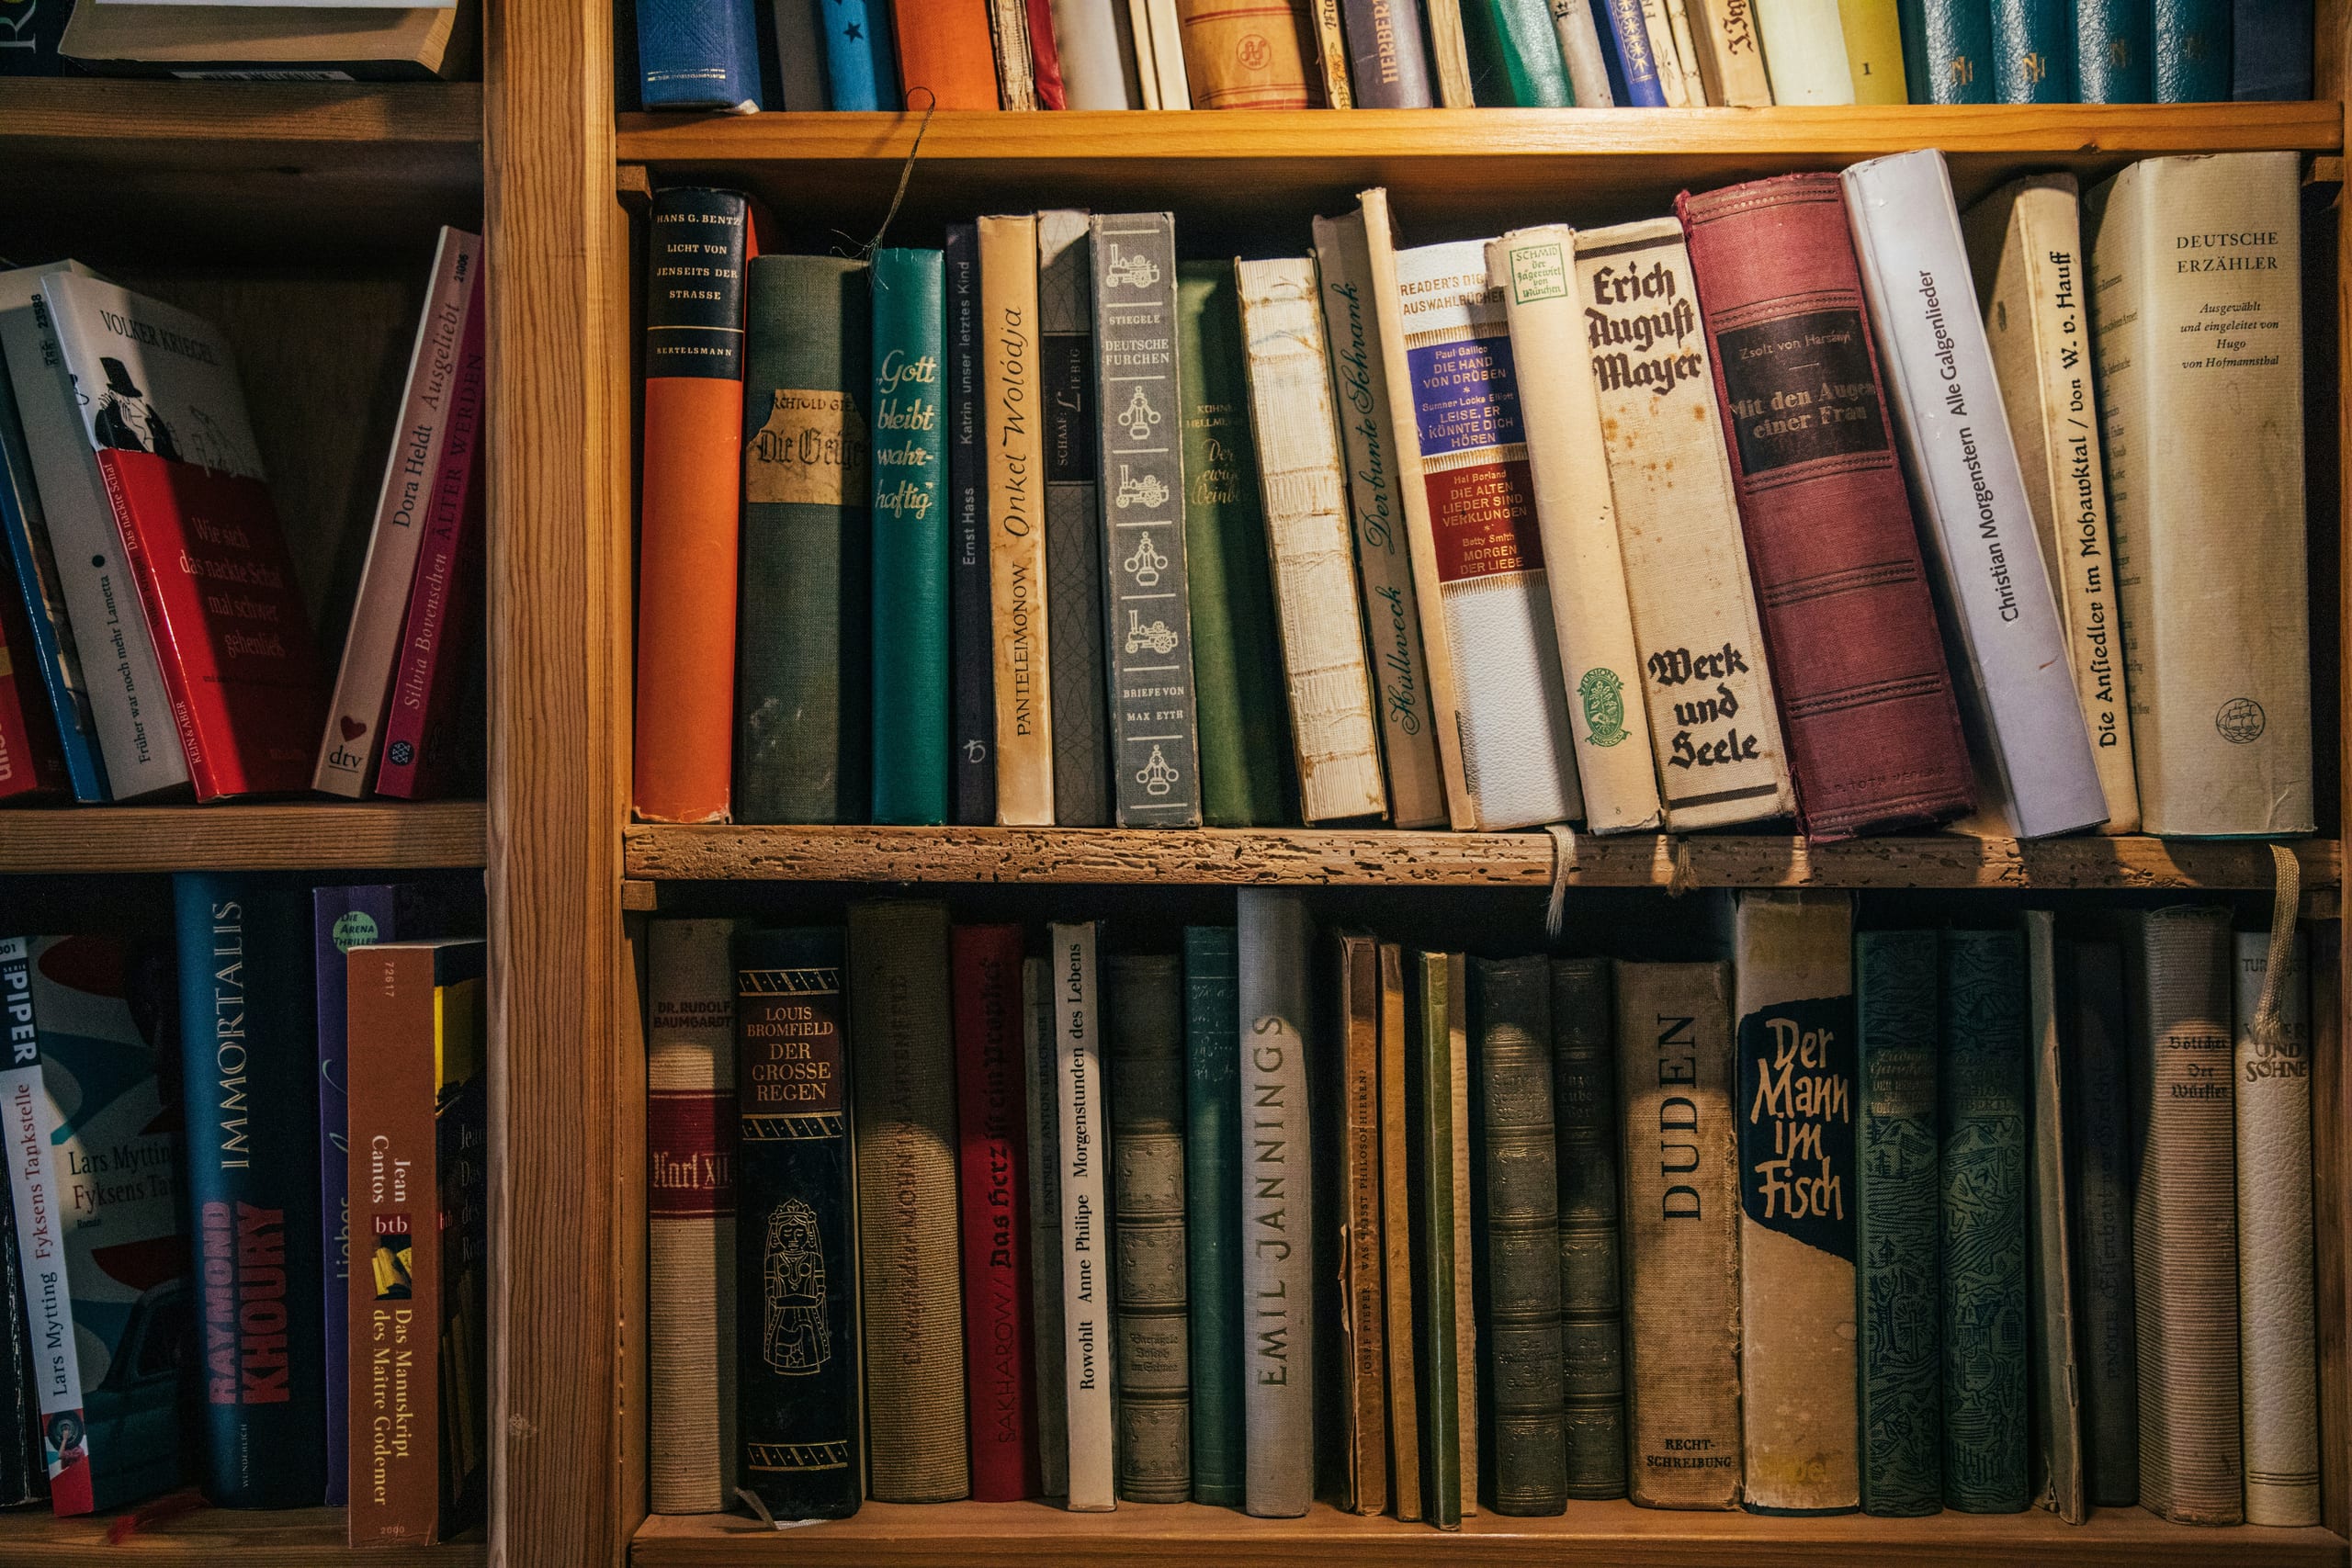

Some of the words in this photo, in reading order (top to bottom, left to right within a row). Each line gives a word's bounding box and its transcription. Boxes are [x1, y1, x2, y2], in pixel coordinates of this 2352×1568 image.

[1379, 0, 1401, 84] HERBER
[656, 213, 685, 225] HANS
[687, 213, 699, 224] G.
[701, 214, 742, 227] BENTZ
[667, 243, 700, 254] LICHT
[704, 244, 728, 255] VON
[1515, 246, 1559, 262] SCHMID
[2176, 231, 2278, 250] DEUTSCHE
[656, 266, 710, 278] JENSEITS
[714, 267, 739, 279] DER
[957, 262, 970, 296] Kind
[2177, 254, 2278, 274] ERZÄHLER
[669, 289, 722, 301] STRASSE
[1521, 283, 1562, 299] München
[1592, 261, 1677, 306] Erich
[30, 293, 49, 329] 23588
[958, 299, 972, 351] letztes
[1108, 314, 1161, 325] STIEGELE
[1584, 298, 1695, 353] August
[1918, 270, 1957, 381] Galgenlieder
[2199, 301, 2261, 316] Ausgewählt
[99, 309, 160, 348] VOLKER
[2180, 321, 2201, 333] und
[2203, 319, 2257, 334] eingeleitet
[2259, 320, 2279, 331] von
[417, 301, 461, 412] Ausgeliebt
[656, 346, 733, 357] BERTELSMANN
[1104, 338, 1170, 353] DEUTSCHE
[1104, 352, 1170, 367] FURCHEN
[1340, 278, 1375, 415] Schrank
[1434, 347, 1456, 361] Paul
[1457, 344, 1488, 359] Gallico
[1739, 343, 1773, 361] Zsolt
[1776, 337, 1802, 352] von
[1804, 329, 1854, 351] Harsányi
[2216, 338, 2246, 351] Hugo
[962, 352, 972, 394] unser
[1002, 306, 1030, 448] Wolódja
[1422, 375, 1450, 389] VON
[1452, 367, 1507, 386] DRÜBEN
[1433, 360, 1456, 375] DIE
[1458, 355, 1494, 371] HAND
[1591, 351, 1702, 396] Mayer
[2181, 359, 2203, 370] von
[2205, 354, 2279, 371] Hofmannsthal
[449, 352, 483, 458] WERDEN
[876, 398, 935, 432] bleibt
[1421, 399, 1458, 413] Sumner
[1459, 395, 1487, 408] Locke
[1488, 391, 1515, 405] Elliott
[1440, 407, 1482, 425] LEISE,
[1483, 404, 1501, 418] ER
[1728, 394, 1765, 423] Mit
[1770, 387, 1814, 411] den
[1816, 379, 1878, 406] Augen
[1940, 385, 1969, 417] Alle
[960, 399, 973, 446] Katrin
[1428, 419, 1481, 440] KÖNNTE
[1482, 416, 1515, 432] DICH
[1752, 415, 1812, 440] einer
[1820, 403, 1869, 427] Frau
[404, 423, 434, 478] Heldt
[876, 441, 934, 467] wahr-
[1355, 417, 1389, 492] bunte
[1451, 431, 1497, 449] HÖREN
[1450, 486, 1474, 500] DIE
[1476, 481, 1514, 497] ALTEN
[1453, 473, 1470, 485] Hal
[1472, 469, 1507, 483] Borland
[1959, 426, 1999, 540] Morgenstern
[392, 481, 420, 529] Dora
[435, 468, 462, 542] ÄLTER
[963, 486, 976, 521] Hass
[1003, 453, 1031, 539] Onkel
[1442, 497, 1489, 514] LIEDER
[1492, 492, 1524, 507] SIND
[1359, 491, 1396, 555] Der
[1442, 506, 1528, 528] VERKLUNGEN
[962, 524, 977, 567] Ernst
[1462, 535, 1487, 548] Betty
[1488, 531, 1515, 544] Smith
[1464, 545, 1518, 562] MORGEN
[1460, 561, 1487, 576] DER
[1487, 556, 1524, 571] LIEBE
[1989, 541, 2019, 624] Christian
[99, 574, 122, 615] Lametta
[413, 552, 448, 654] Bovenschen
[111, 616, 131, 651] mehr
[1012, 563, 1032, 739] PANTELEIMONOW
[120, 653, 138, 687] noch
[1646, 642, 1750, 687] Werk
[130, 689, 144, 715] war
[403, 659, 430, 711] Silvia
[1123, 686, 1161, 699] BRIEFE
[1161, 685, 1185, 697] VON
[1126, 711, 1150, 723] MAX
[1156, 710, 1184, 721] EYTH
[1674, 682, 1740, 728] und
[135, 716, 152, 765] Früher
[1667, 728, 1762, 771] Seele
[329, 745, 363, 773] dtv
[341, 911, 359, 924] DIE
[341, 922, 375, 935] ARENA
[333, 934, 378, 949] THRILLER
[384, 962, 395, 998] 72617
[1067, 942, 1083, 1005] Lebens
[4, 970, 38, 1066] PIPER
[653, 1015, 732, 1030] BAUMGARDT
[682, 1000, 730, 1014] RUDOLF
[765, 1006, 813, 1021] LOUIS
[1069, 1009, 1084, 1040] des
[211, 900, 251, 1171] IMMORTALIS
[746, 1021, 834, 1037] BROMFIELD
[1765, 1017, 1836, 1071] Der
[769, 1042, 812, 1061] DER
[2255, 1043, 2302, 1058] UND
[752, 1061, 832, 1081] GROSSE
[2245, 1058, 2309, 1083] SÖHNE
[756, 1082, 828, 1101] REGEN
[1749, 1057, 1849, 1124] Mann
[1070, 1047, 1091, 1179] Morgenstunden
[1657, 1012, 1702, 1222] DUDEN
[15, 1083, 42, 1181] Tankstelle
[1252, 1012, 1292, 1264] JANNINGS
[1774, 1118, 1824, 1161] im
[371, 1135, 390, 1205] Cantos
[394, 1158, 412, 1203] Jean
[1754, 1156, 1845, 1221] Fisch
[29, 1182, 53, 1260] Fyksens
[375, 1215, 409, 1235] btb
[1074, 1193, 1093, 1253] Philipe
[1077, 1258, 1092, 1304] Anne
[40, 1271, 65, 1348] Mytting
[202, 1201, 237, 1405] RAYMOND
[235, 1200, 291, 1405] KHOURY
[374, 1309, 391, 1343] des
[396, 1309, 413, 1345] Das
[1256, 1279, 1288, 1389] EMIL
[52, 1348, 69, 1396] Lars
[1078, 1319, 1095, 1392] Rowohlt
[373, 1347, 391, 1412] Maître
[395, 1349, 413, 1459] Manuskript
[372, 1416, 391, 1506] Godemer
[1646, 1454, 1732, 1470] SCHREIBUNG
[1664, 1438, 1716, 1452] RECHT-
